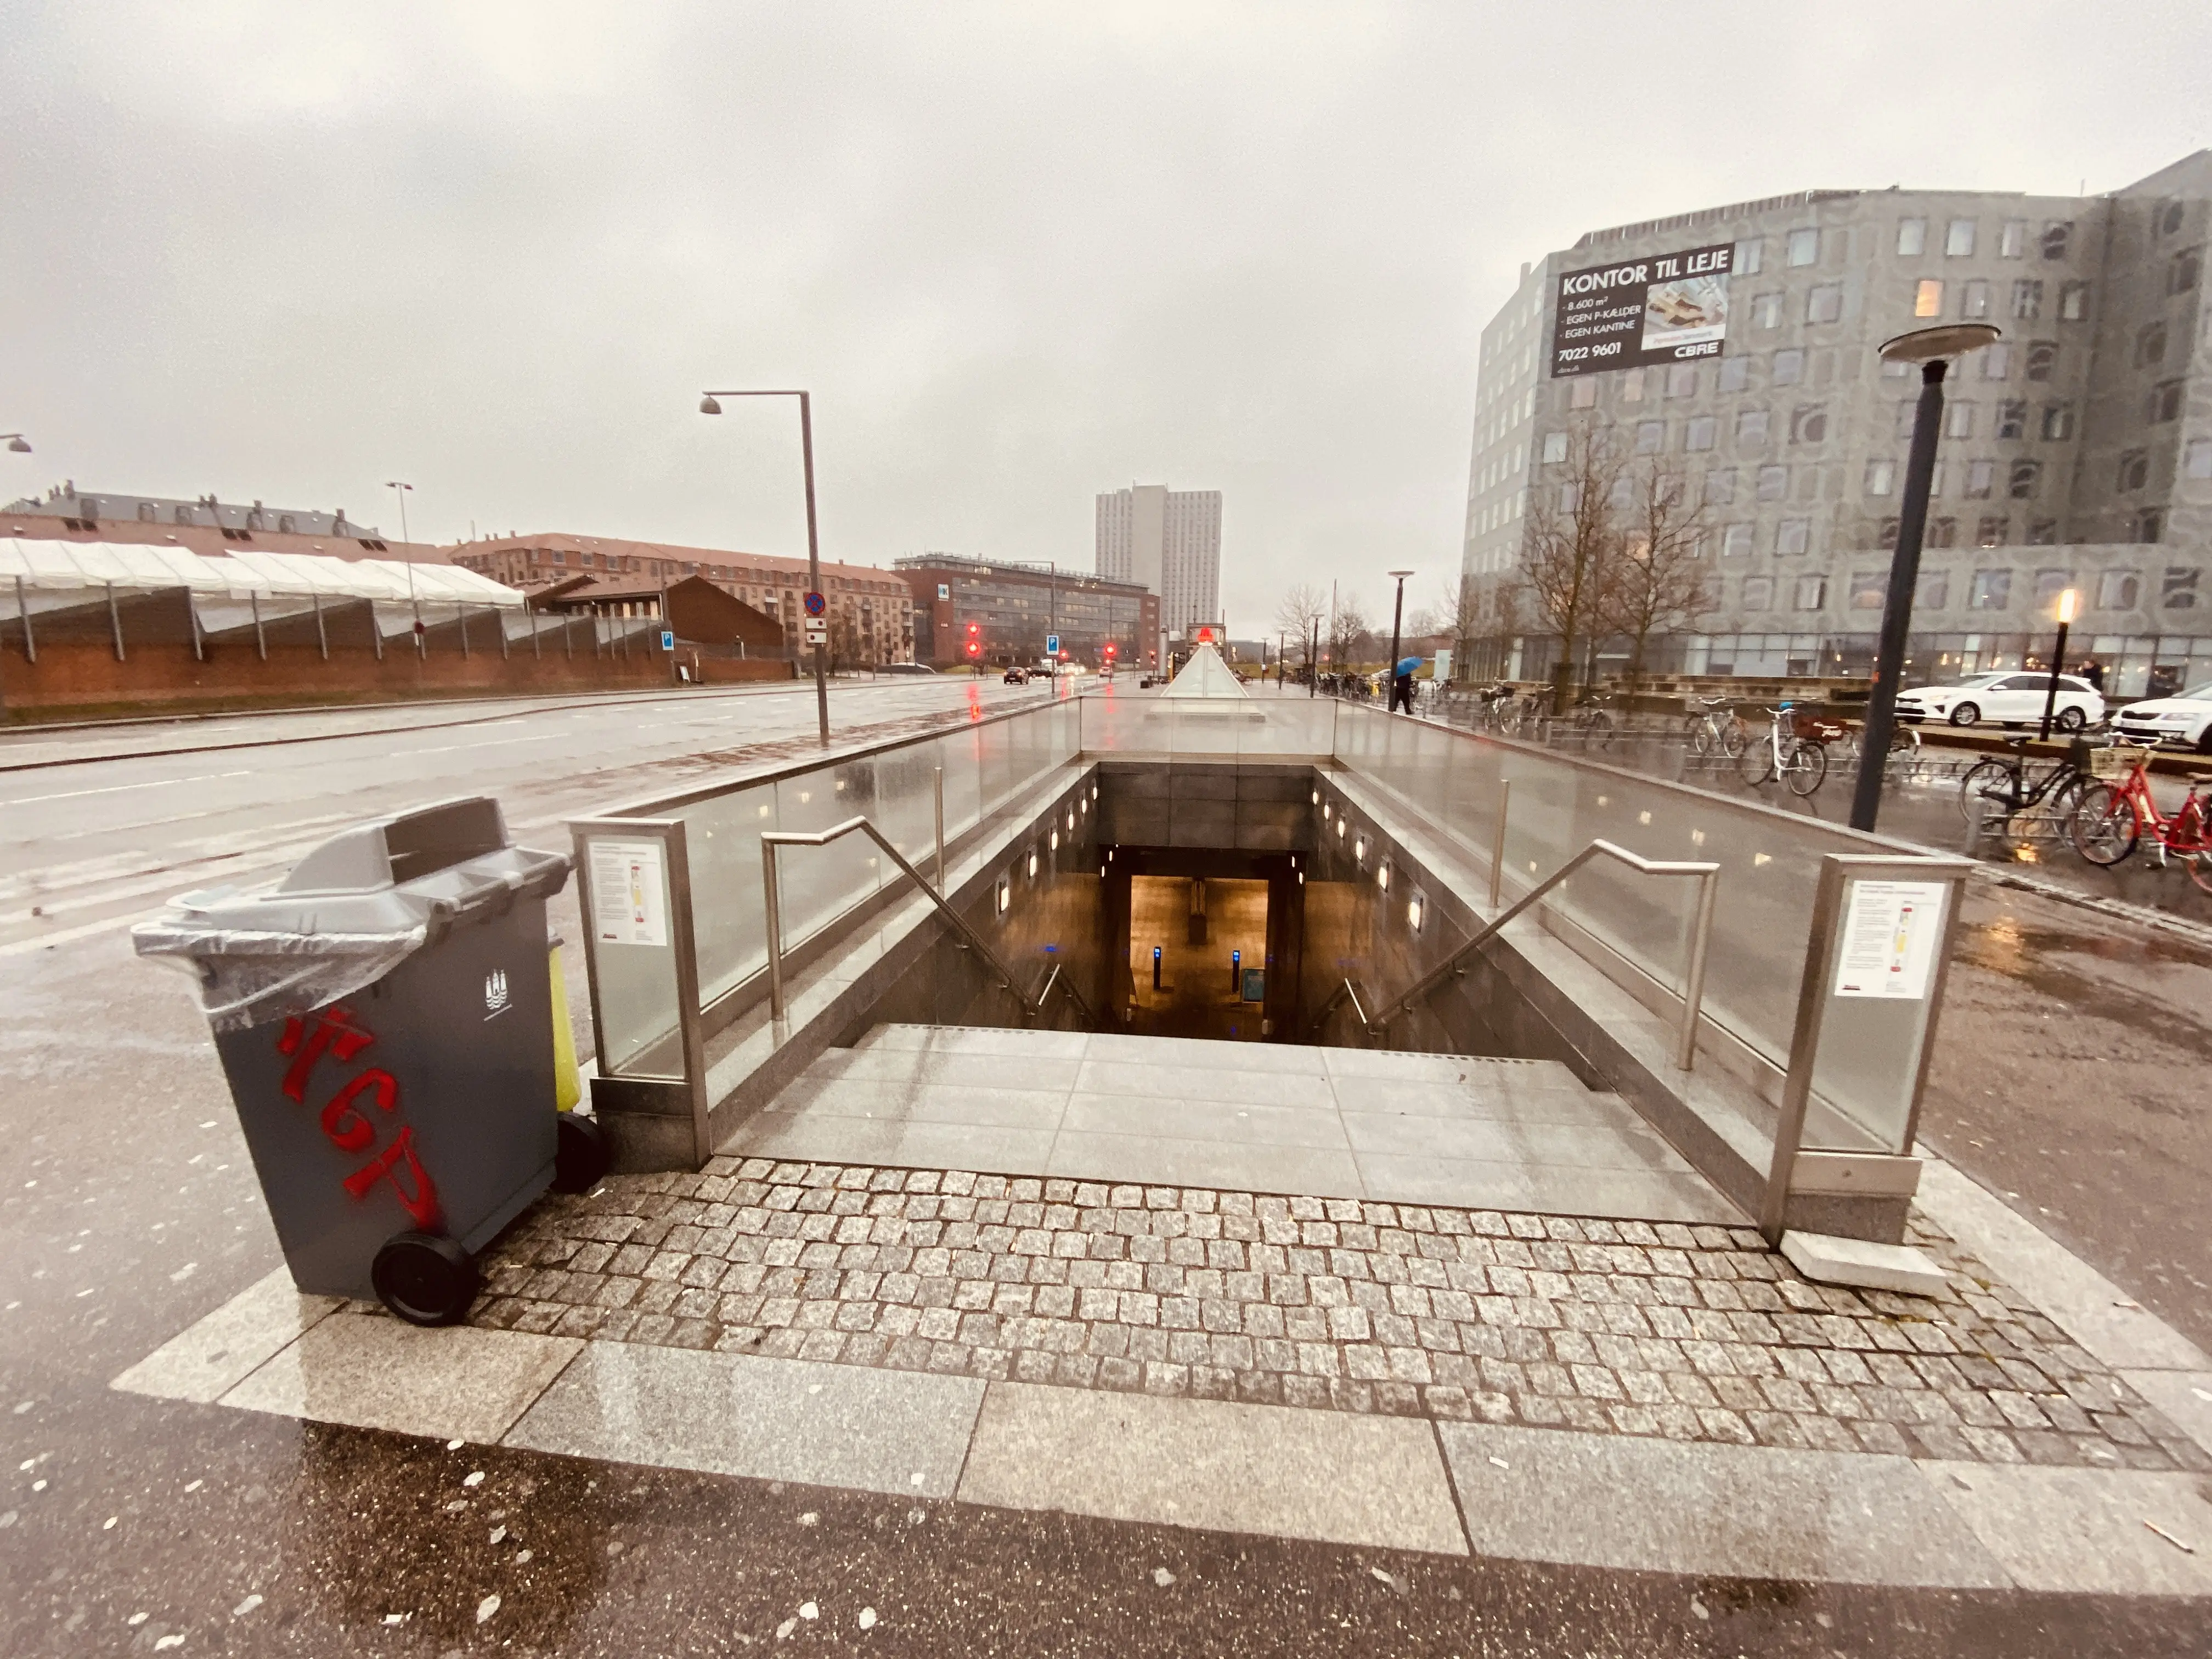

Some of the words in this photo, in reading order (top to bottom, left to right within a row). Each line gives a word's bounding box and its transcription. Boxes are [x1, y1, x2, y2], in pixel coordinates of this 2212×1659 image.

[1564, 264, 1647, 296] KONTOR
[1655, 258, 1680, 279] TIL
[1687, 250, 1729, 274] LEJE
[1568, 298, 1594, 311] 8.600
[1566, 313, 1592, 325] EGEN
[1594, 304, 1641, 320] P-KÆLDER
[1565, 326, 1592, 338] EGEN
[1593, 320, 1635, 334] KANTINE
[1559, 346, 1589, 362] 7022
[1592, 341, 1622, 357] 9601
[1674, 342, 1719, 358] CBRE
